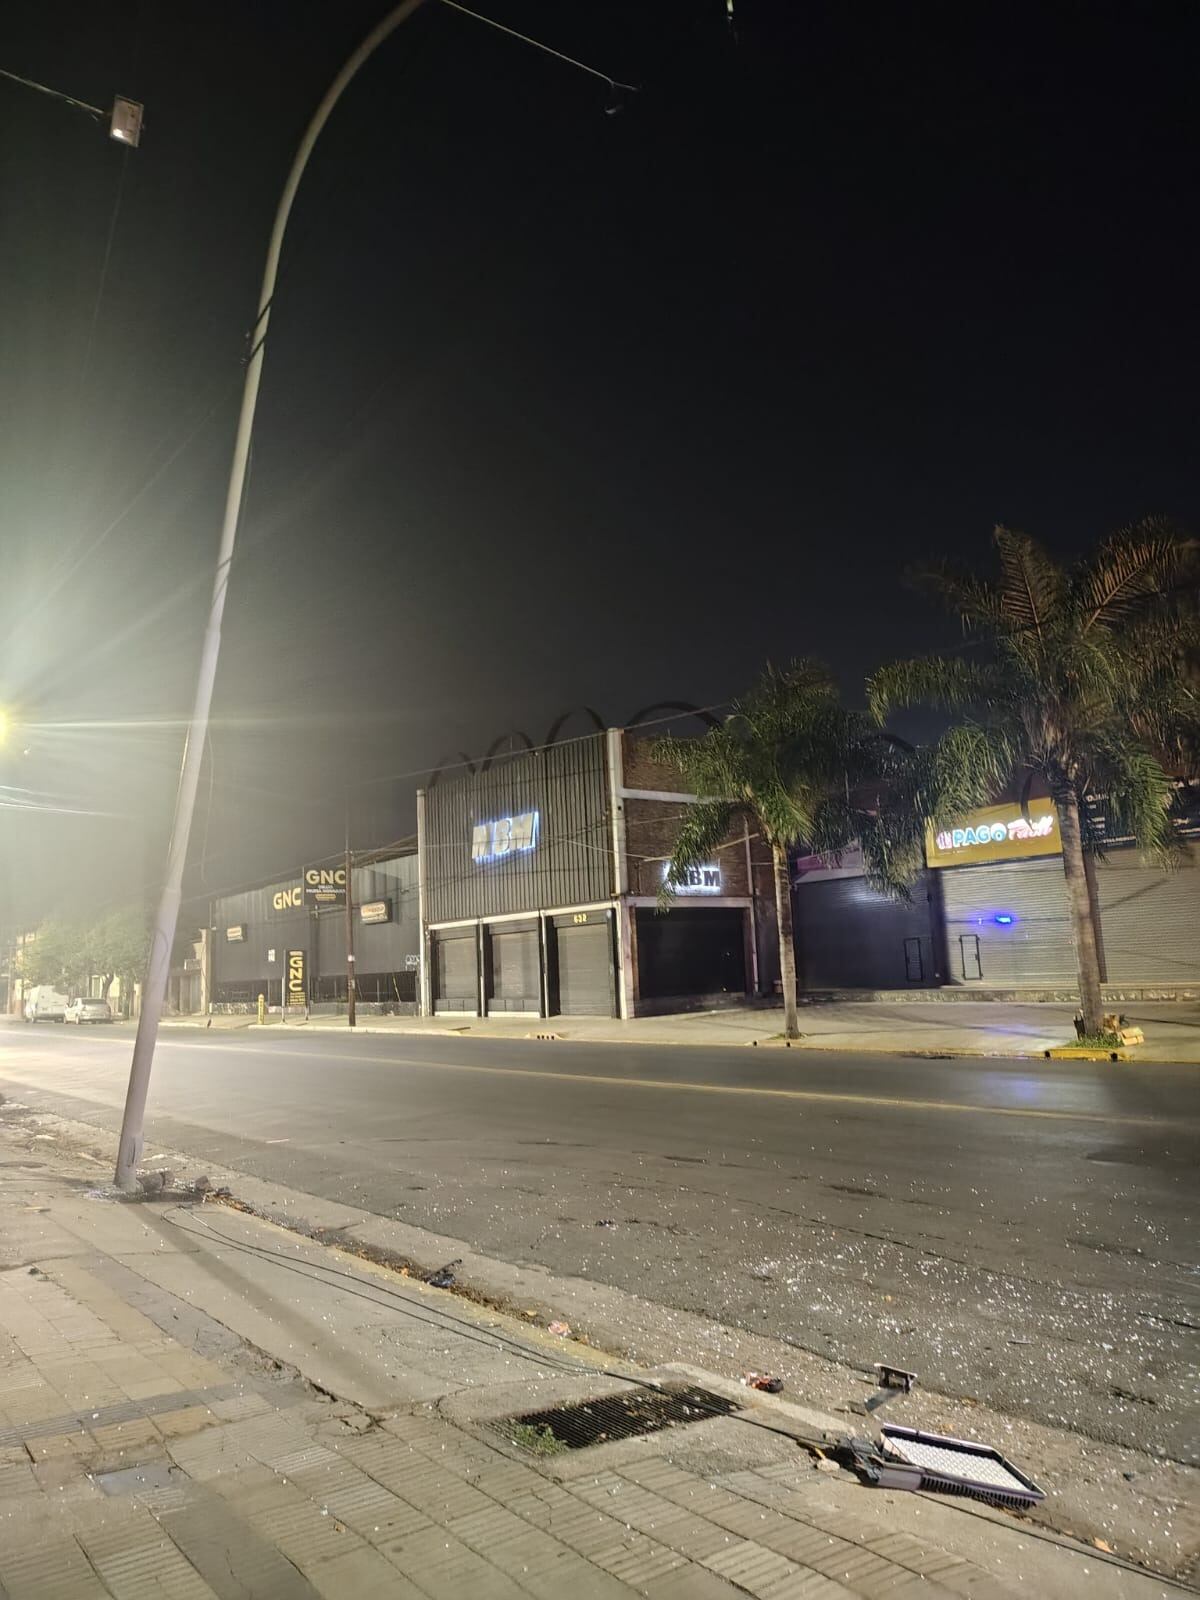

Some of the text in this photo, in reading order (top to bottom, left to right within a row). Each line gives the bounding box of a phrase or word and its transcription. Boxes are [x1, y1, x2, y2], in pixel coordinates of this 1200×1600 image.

[952, 822, 1007, 848] PAGO
[305, 869, 346, 885] GNC
[273, 887, 302, 910] GNC
[289, 956, 304, 992] GNC
